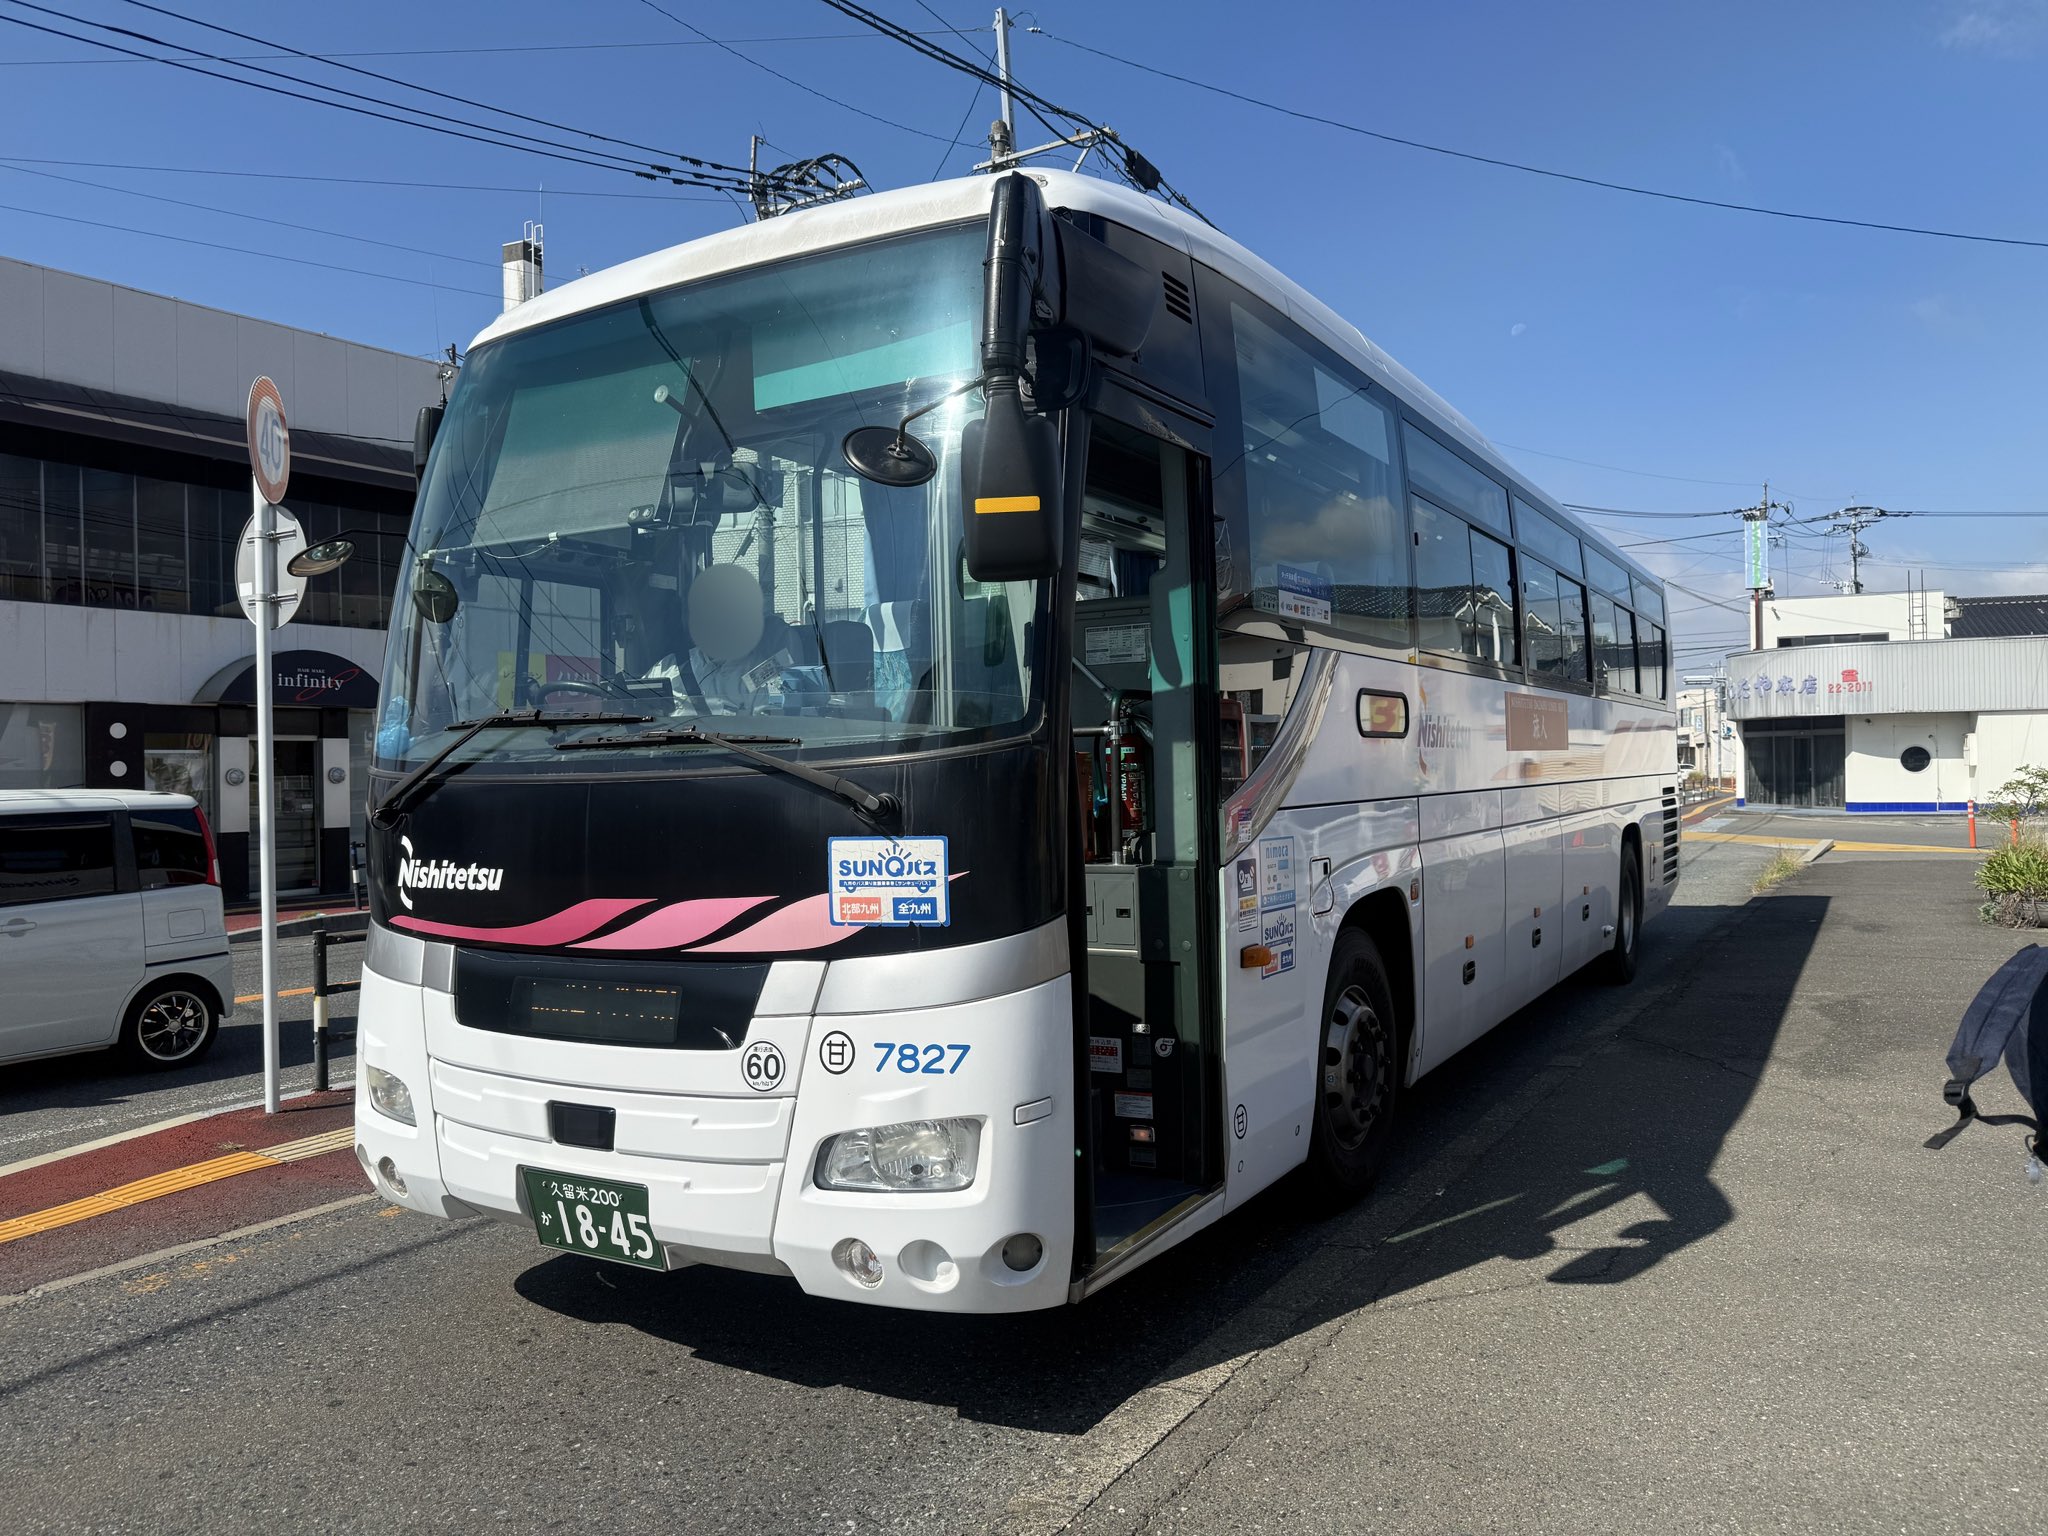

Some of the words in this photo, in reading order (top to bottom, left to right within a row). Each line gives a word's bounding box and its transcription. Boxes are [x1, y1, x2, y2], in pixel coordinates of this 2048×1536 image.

[260, 412, 282, 471] 40
[277, 673, 343, 691] infinity
[1827, 681, 1873, 694] 22-2011
[1416, 713, 1471, 750] Nishitetsu
[1265, 843, 1289, 859] nimoca
[397, 856, 504, 892] Nishitetsu
[838, 855, 937, 878] SUNQパス
[842, 903, 880, 915] 北部九州
[898, 902, 932, 915] 全九州
[747, 1053, 781, 1081] 60
[873, 1042, 972, 1075] 7827
[550, 1181, 621, 1207] 久留米200
[540, 1211, 553, 1226] か
[557, 1200, 654, 1259] 18-45
